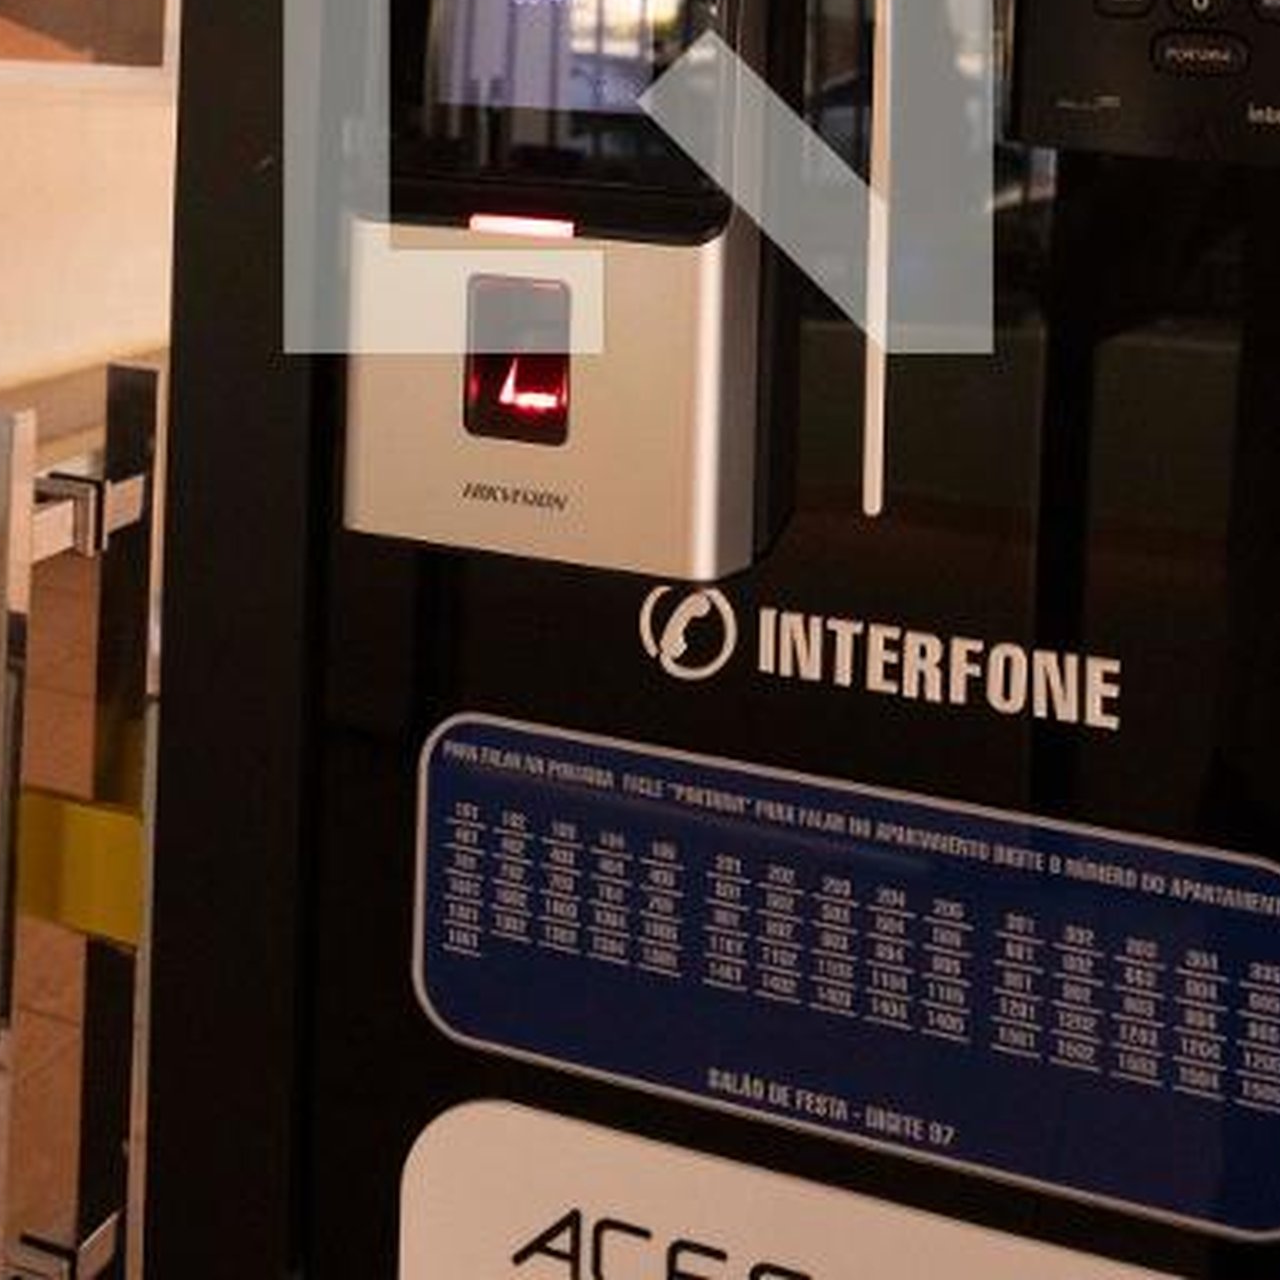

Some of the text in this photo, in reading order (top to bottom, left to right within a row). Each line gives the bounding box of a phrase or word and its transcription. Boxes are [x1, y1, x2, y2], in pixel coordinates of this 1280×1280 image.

[463, 482, 568, 511] HIKVISION
[757, 606, 1121, 731] INTERFONE
[770, 1082, 790, 1107] DE
[795, 1089, 848, 1120] FESTA
[865, 1105, 924, 1141] DIGITE
[929, 1122, 955, 1145] 97
